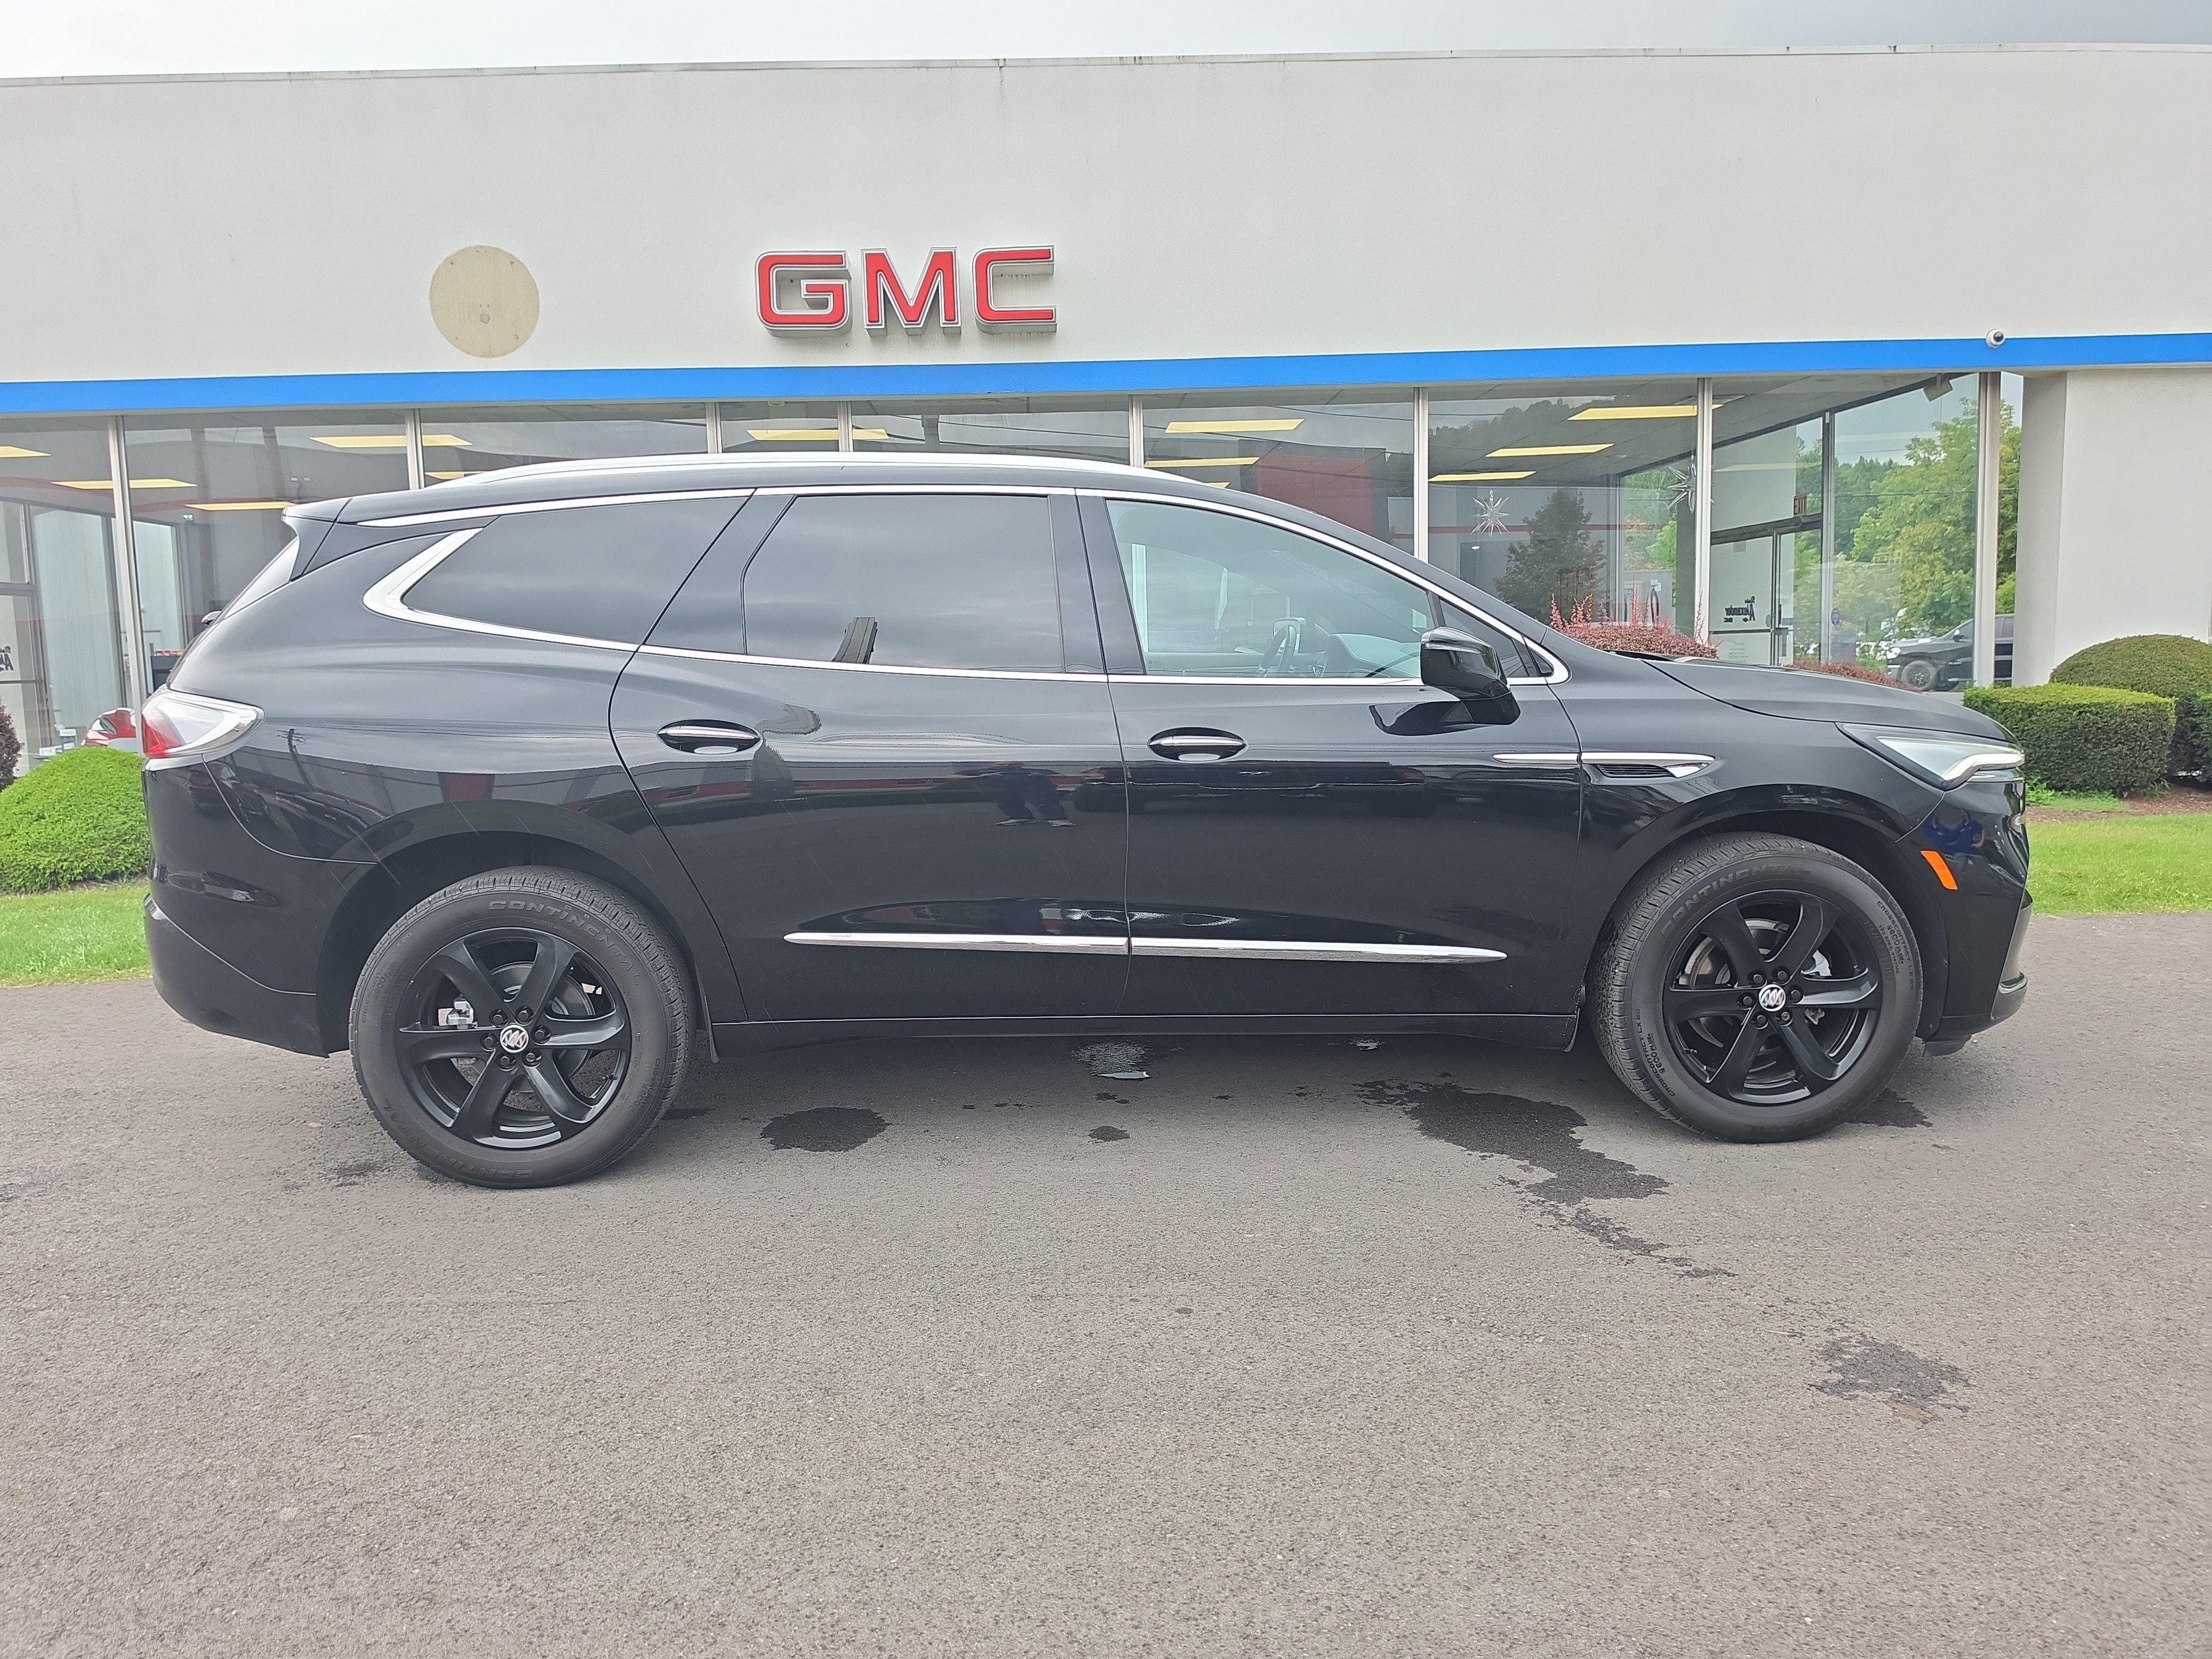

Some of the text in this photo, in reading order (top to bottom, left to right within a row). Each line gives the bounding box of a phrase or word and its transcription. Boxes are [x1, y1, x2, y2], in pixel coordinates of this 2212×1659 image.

[755, 245, 1057, 333] GMC
[1661, 864, 1812, 938] CONTINENTAL
[488, 899, 640, 986] CONTINENTAL
[1636, 1022, 1642, 1033] LX
[1639, 1037, 1675, 1097] CROSSCONTACT
